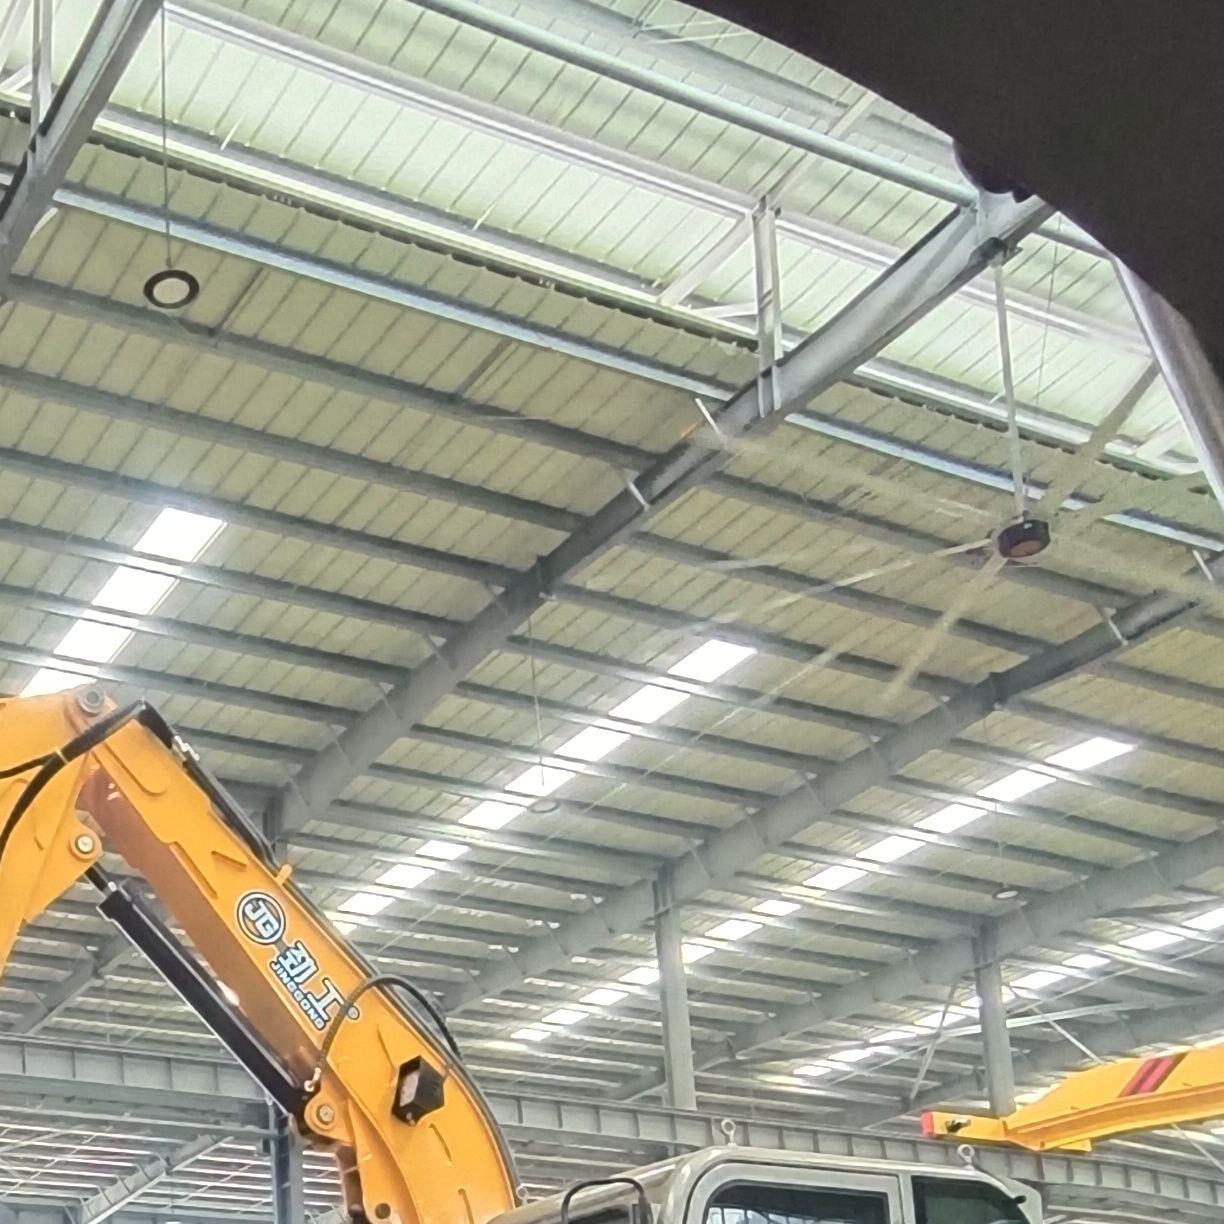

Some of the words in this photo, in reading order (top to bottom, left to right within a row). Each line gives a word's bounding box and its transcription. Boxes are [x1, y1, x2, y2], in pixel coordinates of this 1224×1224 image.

[241, 897, 283, 941] JG
[270, 961, 326, 1030] JINGGONG
[277, 940, 345, 1022] 劲工
